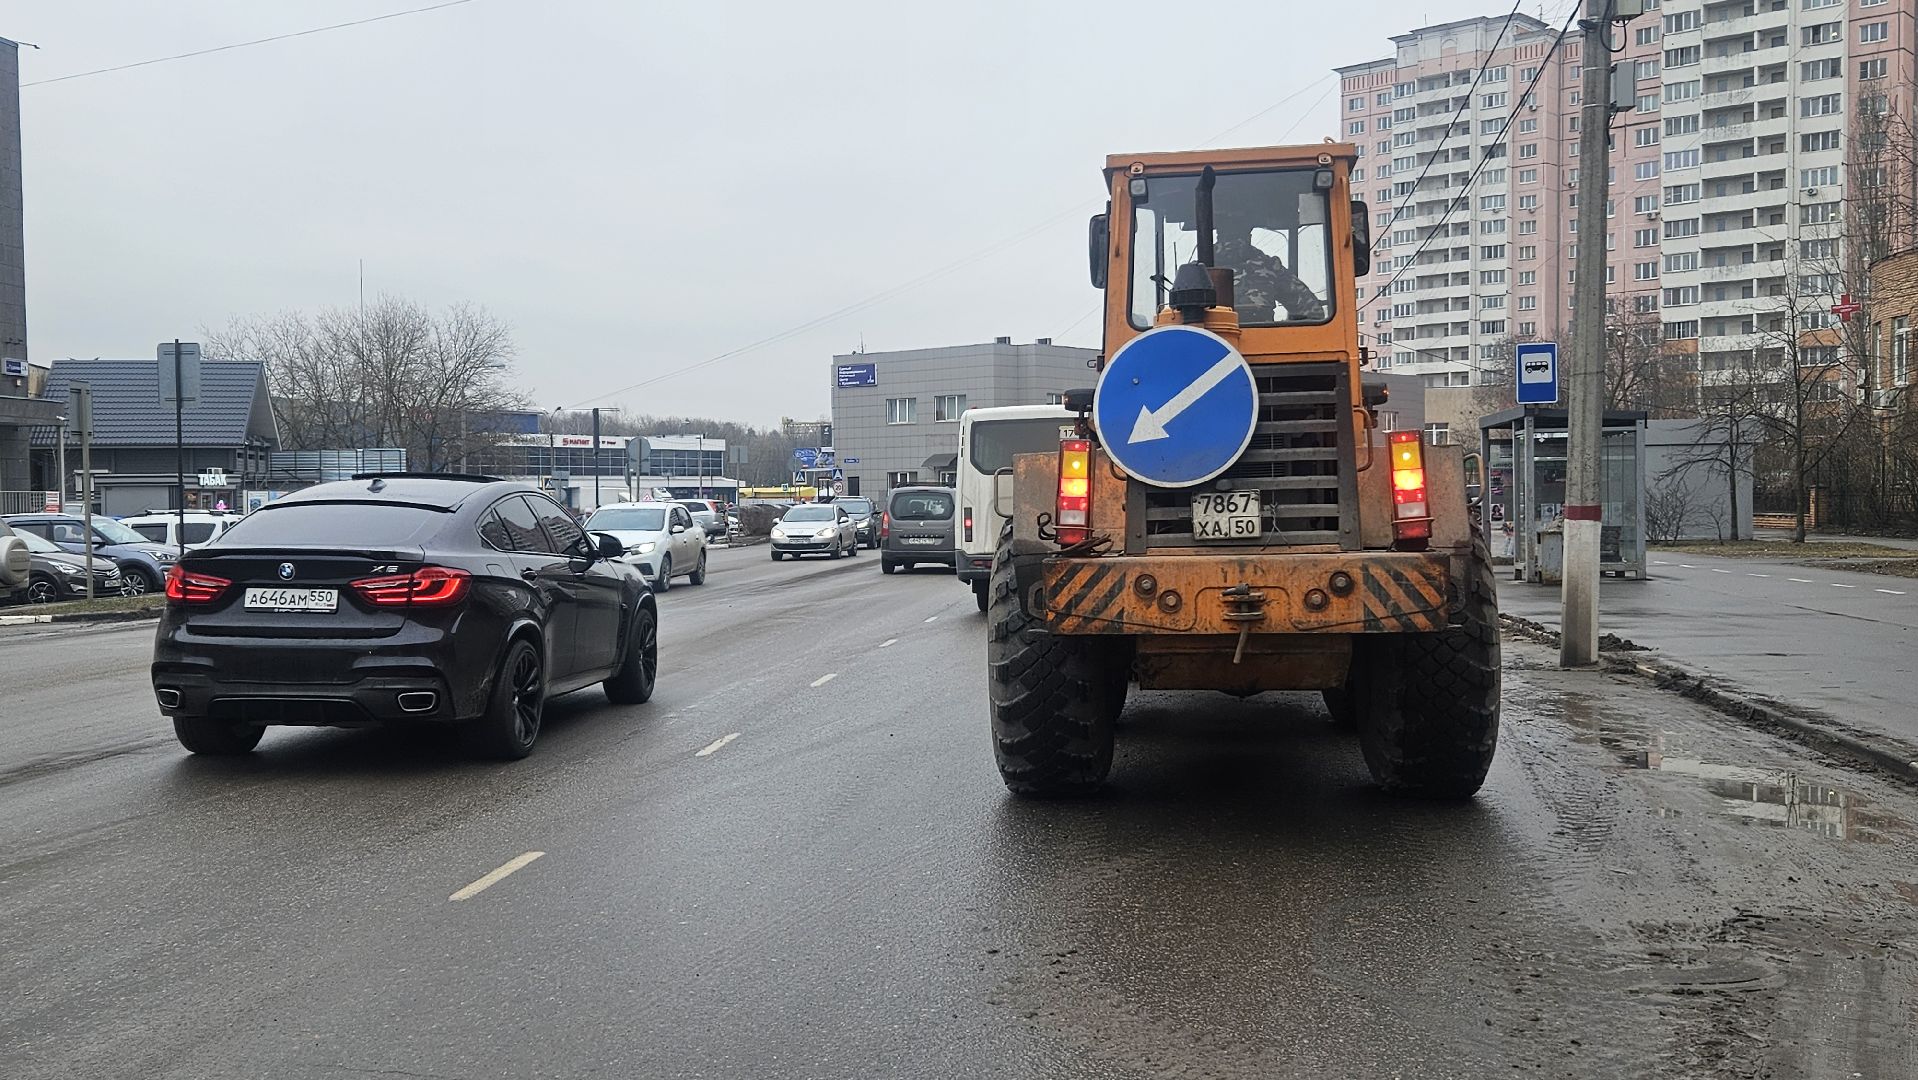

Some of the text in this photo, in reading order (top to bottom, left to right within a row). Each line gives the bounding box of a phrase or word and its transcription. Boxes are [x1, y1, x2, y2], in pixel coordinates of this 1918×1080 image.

[198, 474, 227, 486] ТАБАК
[1200, 494, 1251, 514] 7867
[1198, 520, 1255, 536] ХА 50
[370, 565, 399, 573] X6
[310, 590, 333, 603] 550
